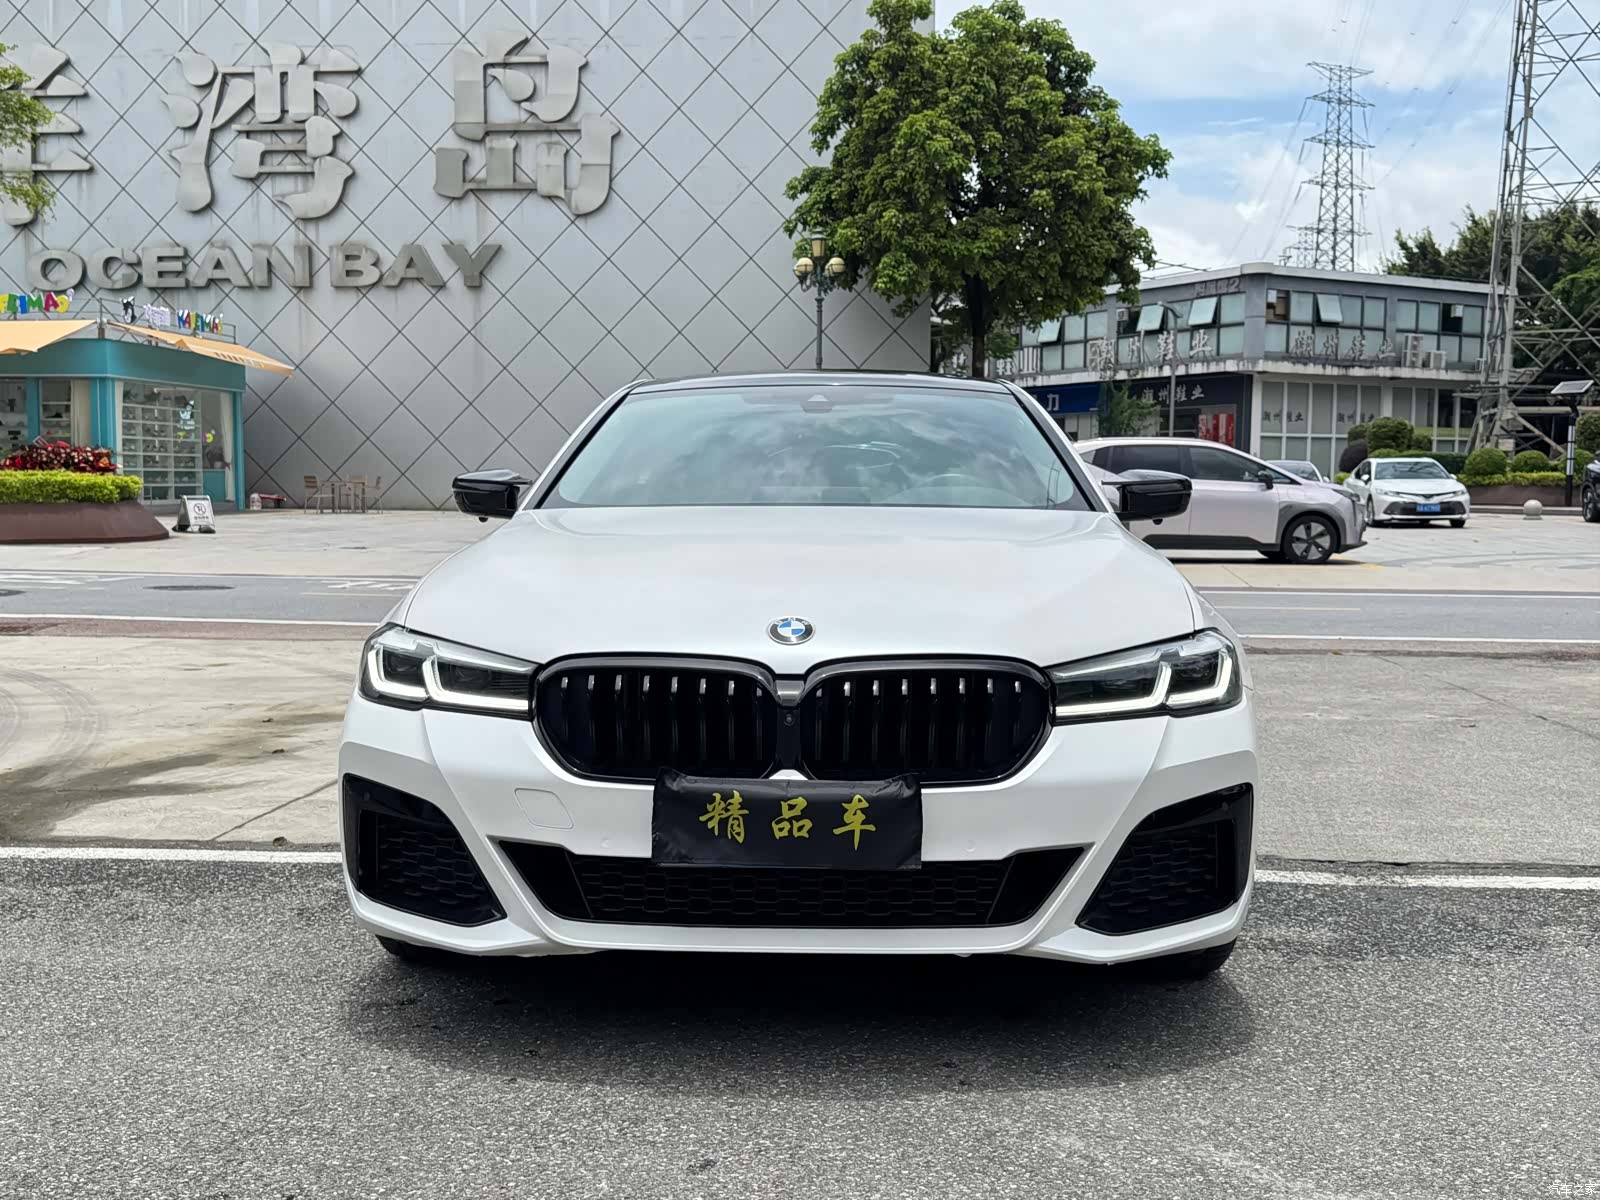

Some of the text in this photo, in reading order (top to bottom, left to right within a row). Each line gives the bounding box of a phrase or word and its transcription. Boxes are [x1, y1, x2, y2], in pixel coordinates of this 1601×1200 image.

[28, 243, 502, 292] OCEAN BAY
[699, 790, 876, 851] 精品车
